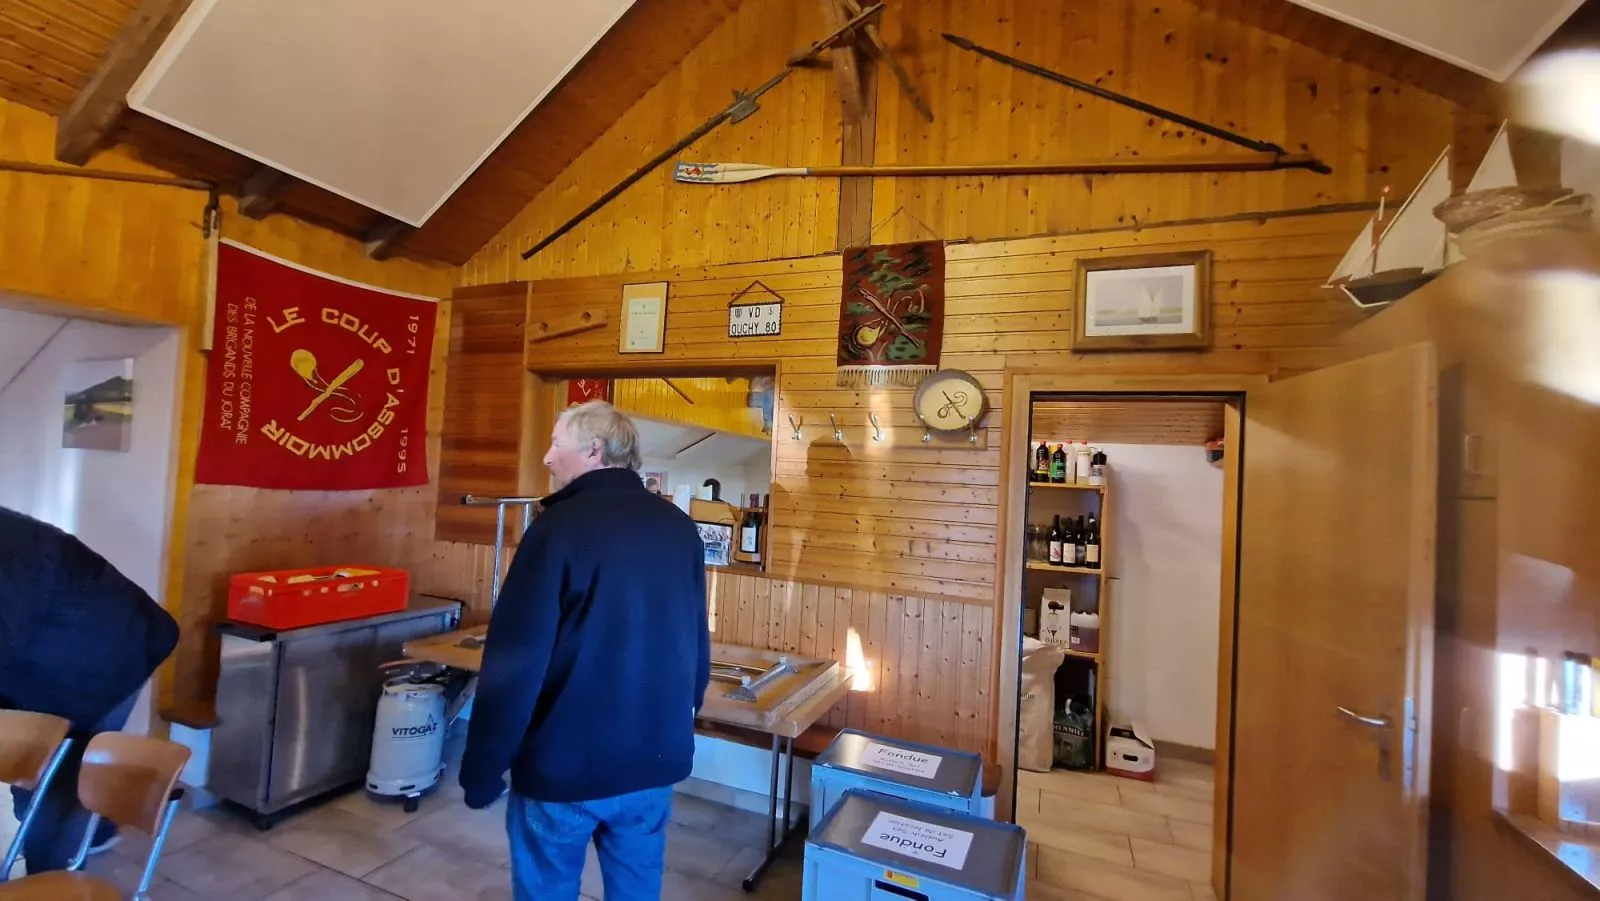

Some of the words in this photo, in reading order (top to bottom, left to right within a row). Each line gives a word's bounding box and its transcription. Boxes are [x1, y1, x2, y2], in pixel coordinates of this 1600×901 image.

[226, 303, 239, 323] DES
[245, 296, 257, 312] DE
[748, 306, 761, 318] VD
[243, 313, 255, 326] LA
[266, 306, 306, 334] LE
[320, 307, 393, 356] COUP
[731, 322, 760, 335] OUCHY
[765, 321, 777, 333] 80
[405, 315, 420, 355] 1971
[222, 325, 238, 379] BRIGANDS
[240, 328, 254, 380] NOUVELLE
[221, 381, 234, 396] DU
[219, 398, 234, 431] JORAT
[235, 381, 252, 446] COMPAGNIE
[396, 428, 409, 474] 1995
[392, 723, 437, 736] VITOGAZ
[878, 748, 929, 763] Fondue
[879, 832, 947, 859] Fondue
